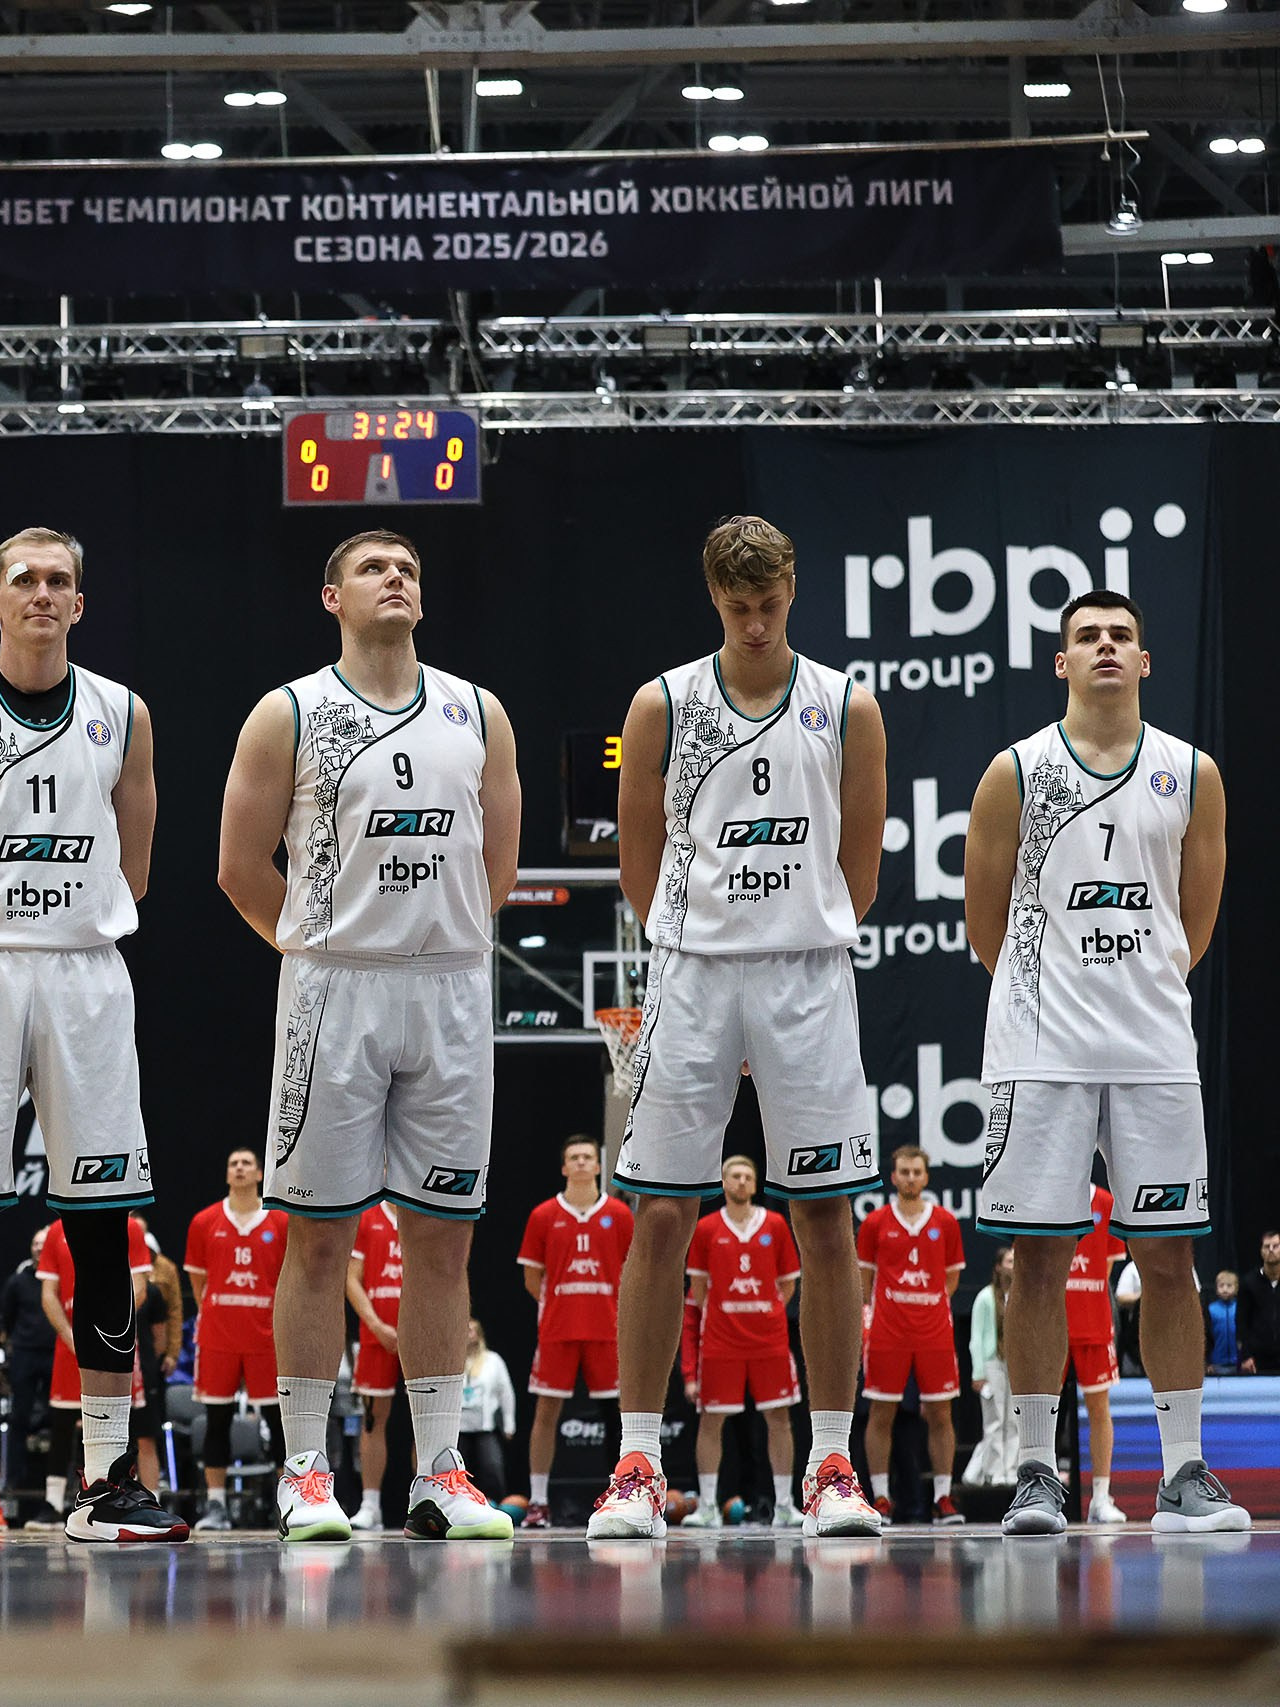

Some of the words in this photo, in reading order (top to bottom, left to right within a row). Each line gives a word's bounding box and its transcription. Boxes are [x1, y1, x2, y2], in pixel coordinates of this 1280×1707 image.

[84, 195, 291, 222] ЧЕМПИОНАТ
[302, 181, 639, 220] КОНТИНЕНТАЛЬНОЙ
[651, 177, 853, 213] ХОККЕЙНОЙ
[866, 180, 952, 205] ЛИГИ
[295, 236, 423, 262] СЕЗОНА
[433, 231, 607, 260] 2025/2026
[352, 411, 435, 440] 3:24
[300, 440, 317, 464] 0
[447, 437, 463, 462] 0
[311, 464, 329, 492] 0
[435, 462, 454, 491] 0
[393, 753, 413, 790] 9
[752, 758, 770, 795] 8
[27, 775, 56, 813] 11
[369, 813, 450, 834] PARI
[721, 820, 806, 845] PARI
[0, 837, 90, 860] PARI
[1099, 823, 1114, 861] 7
[378, 884, 409, 895] group
[727, 892, 761, 904] group
[1071, 884, 1152, 907] PAR
[6, 910, 40, 921] group
[851, 920, 979, 969] grou
[1082, 956, 1115, 967] group
[505, 1011, 558, 1026] PARI
[908, 1247, 919, 1266] 4
